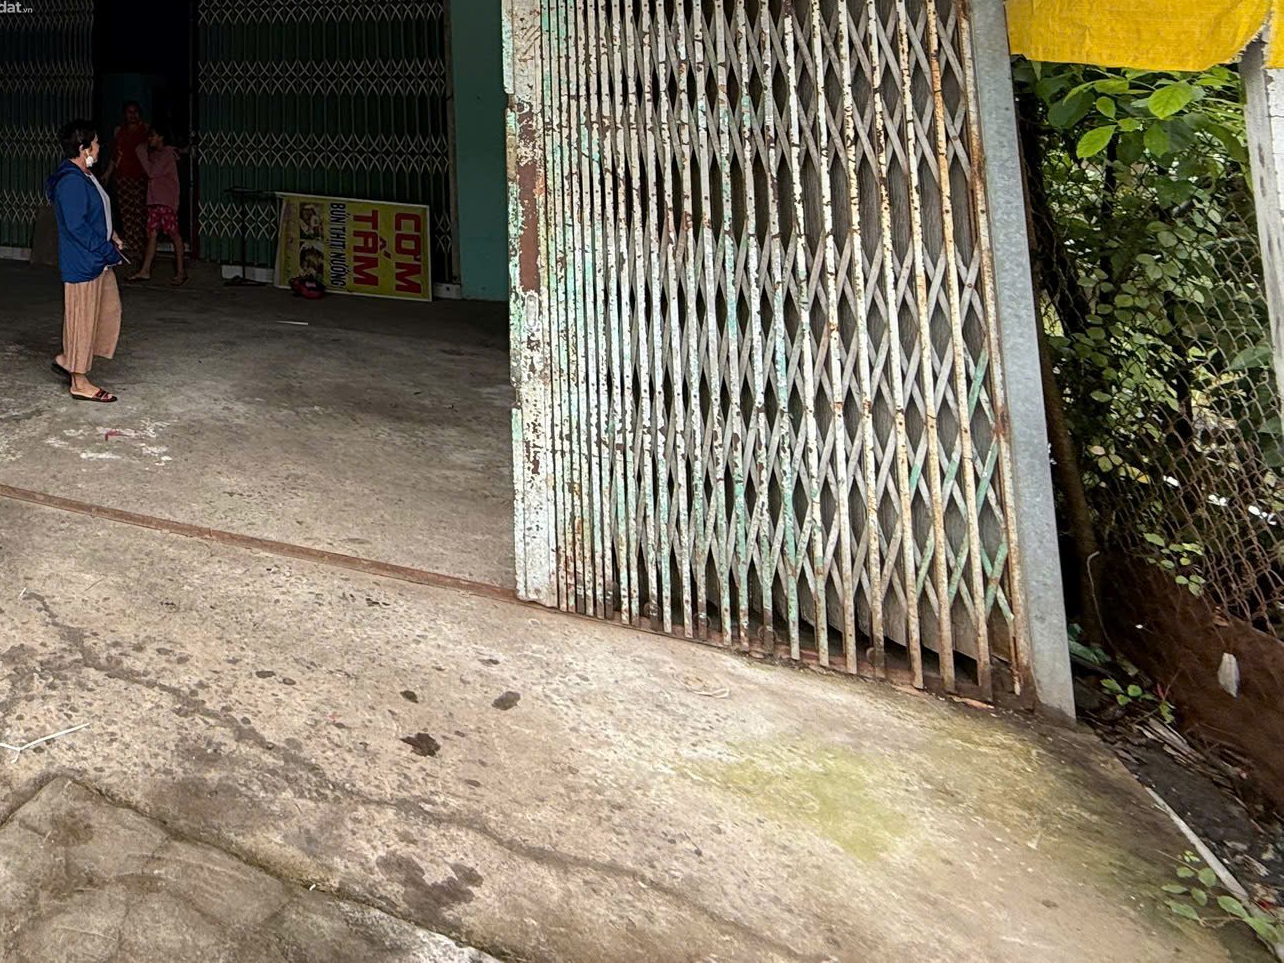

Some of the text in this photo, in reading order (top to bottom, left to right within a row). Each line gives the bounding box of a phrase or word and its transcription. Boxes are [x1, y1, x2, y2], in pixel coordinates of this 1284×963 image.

[328, 202, 350, 287] BÚN THỊT NƯỚNG
[353, 209, 392, 287] TẤM
[394, 212, 422, 294] CƠM
